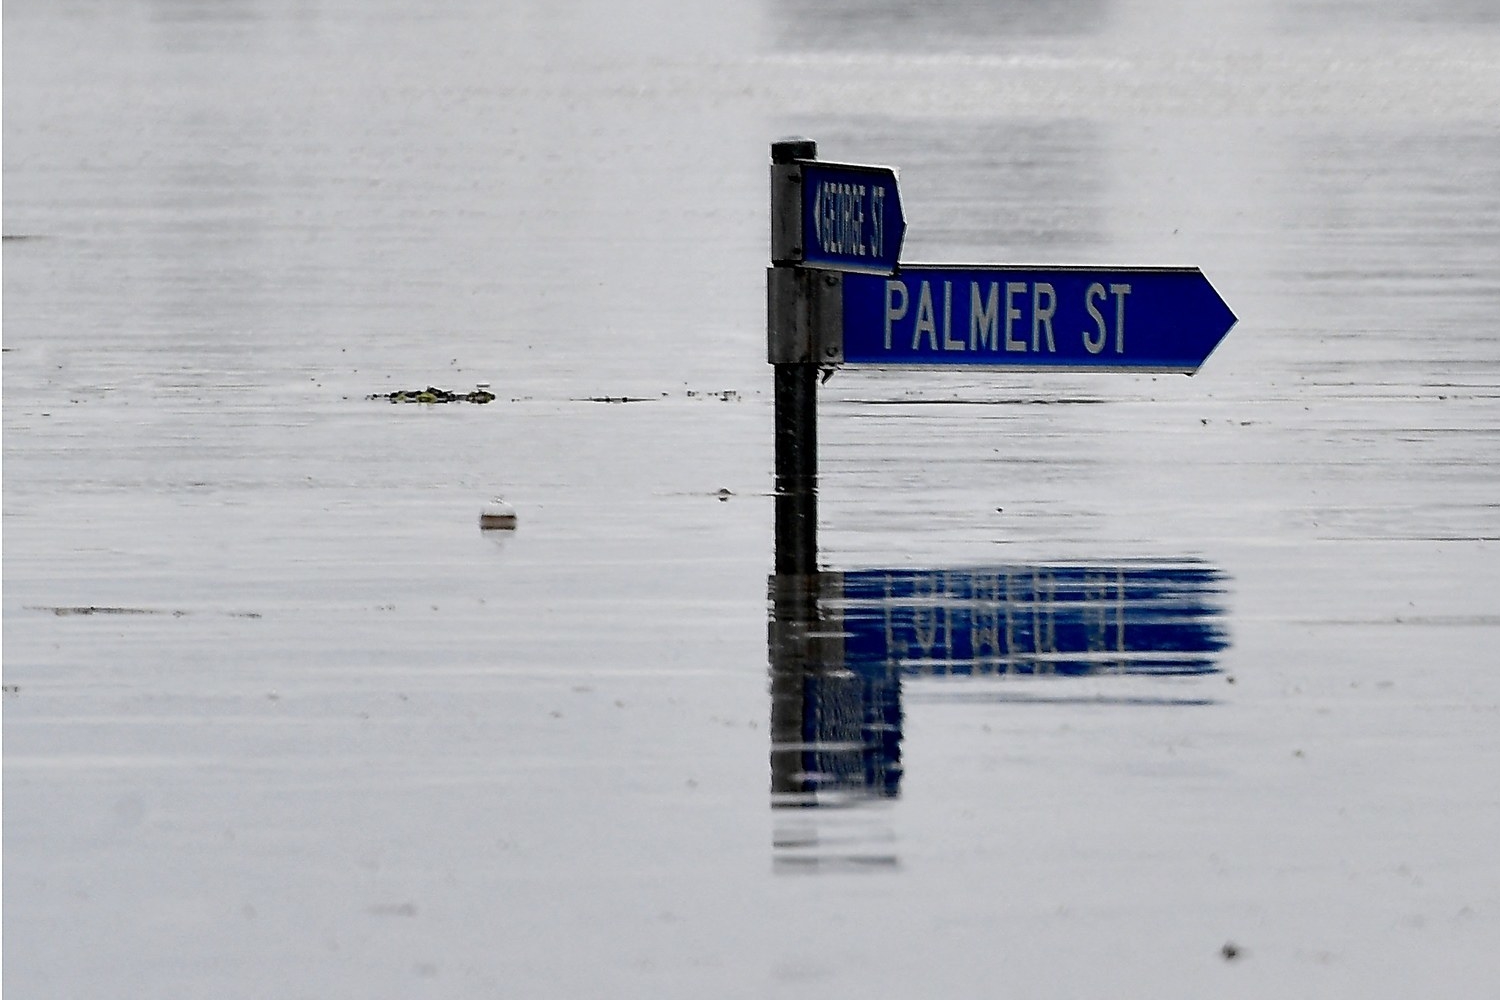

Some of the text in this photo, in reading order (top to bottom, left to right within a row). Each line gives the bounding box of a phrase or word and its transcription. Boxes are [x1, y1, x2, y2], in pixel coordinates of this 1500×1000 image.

[822, 181, 885, 257] GEORGE ST
[884, 281, 1132, 354] PALMER ST
